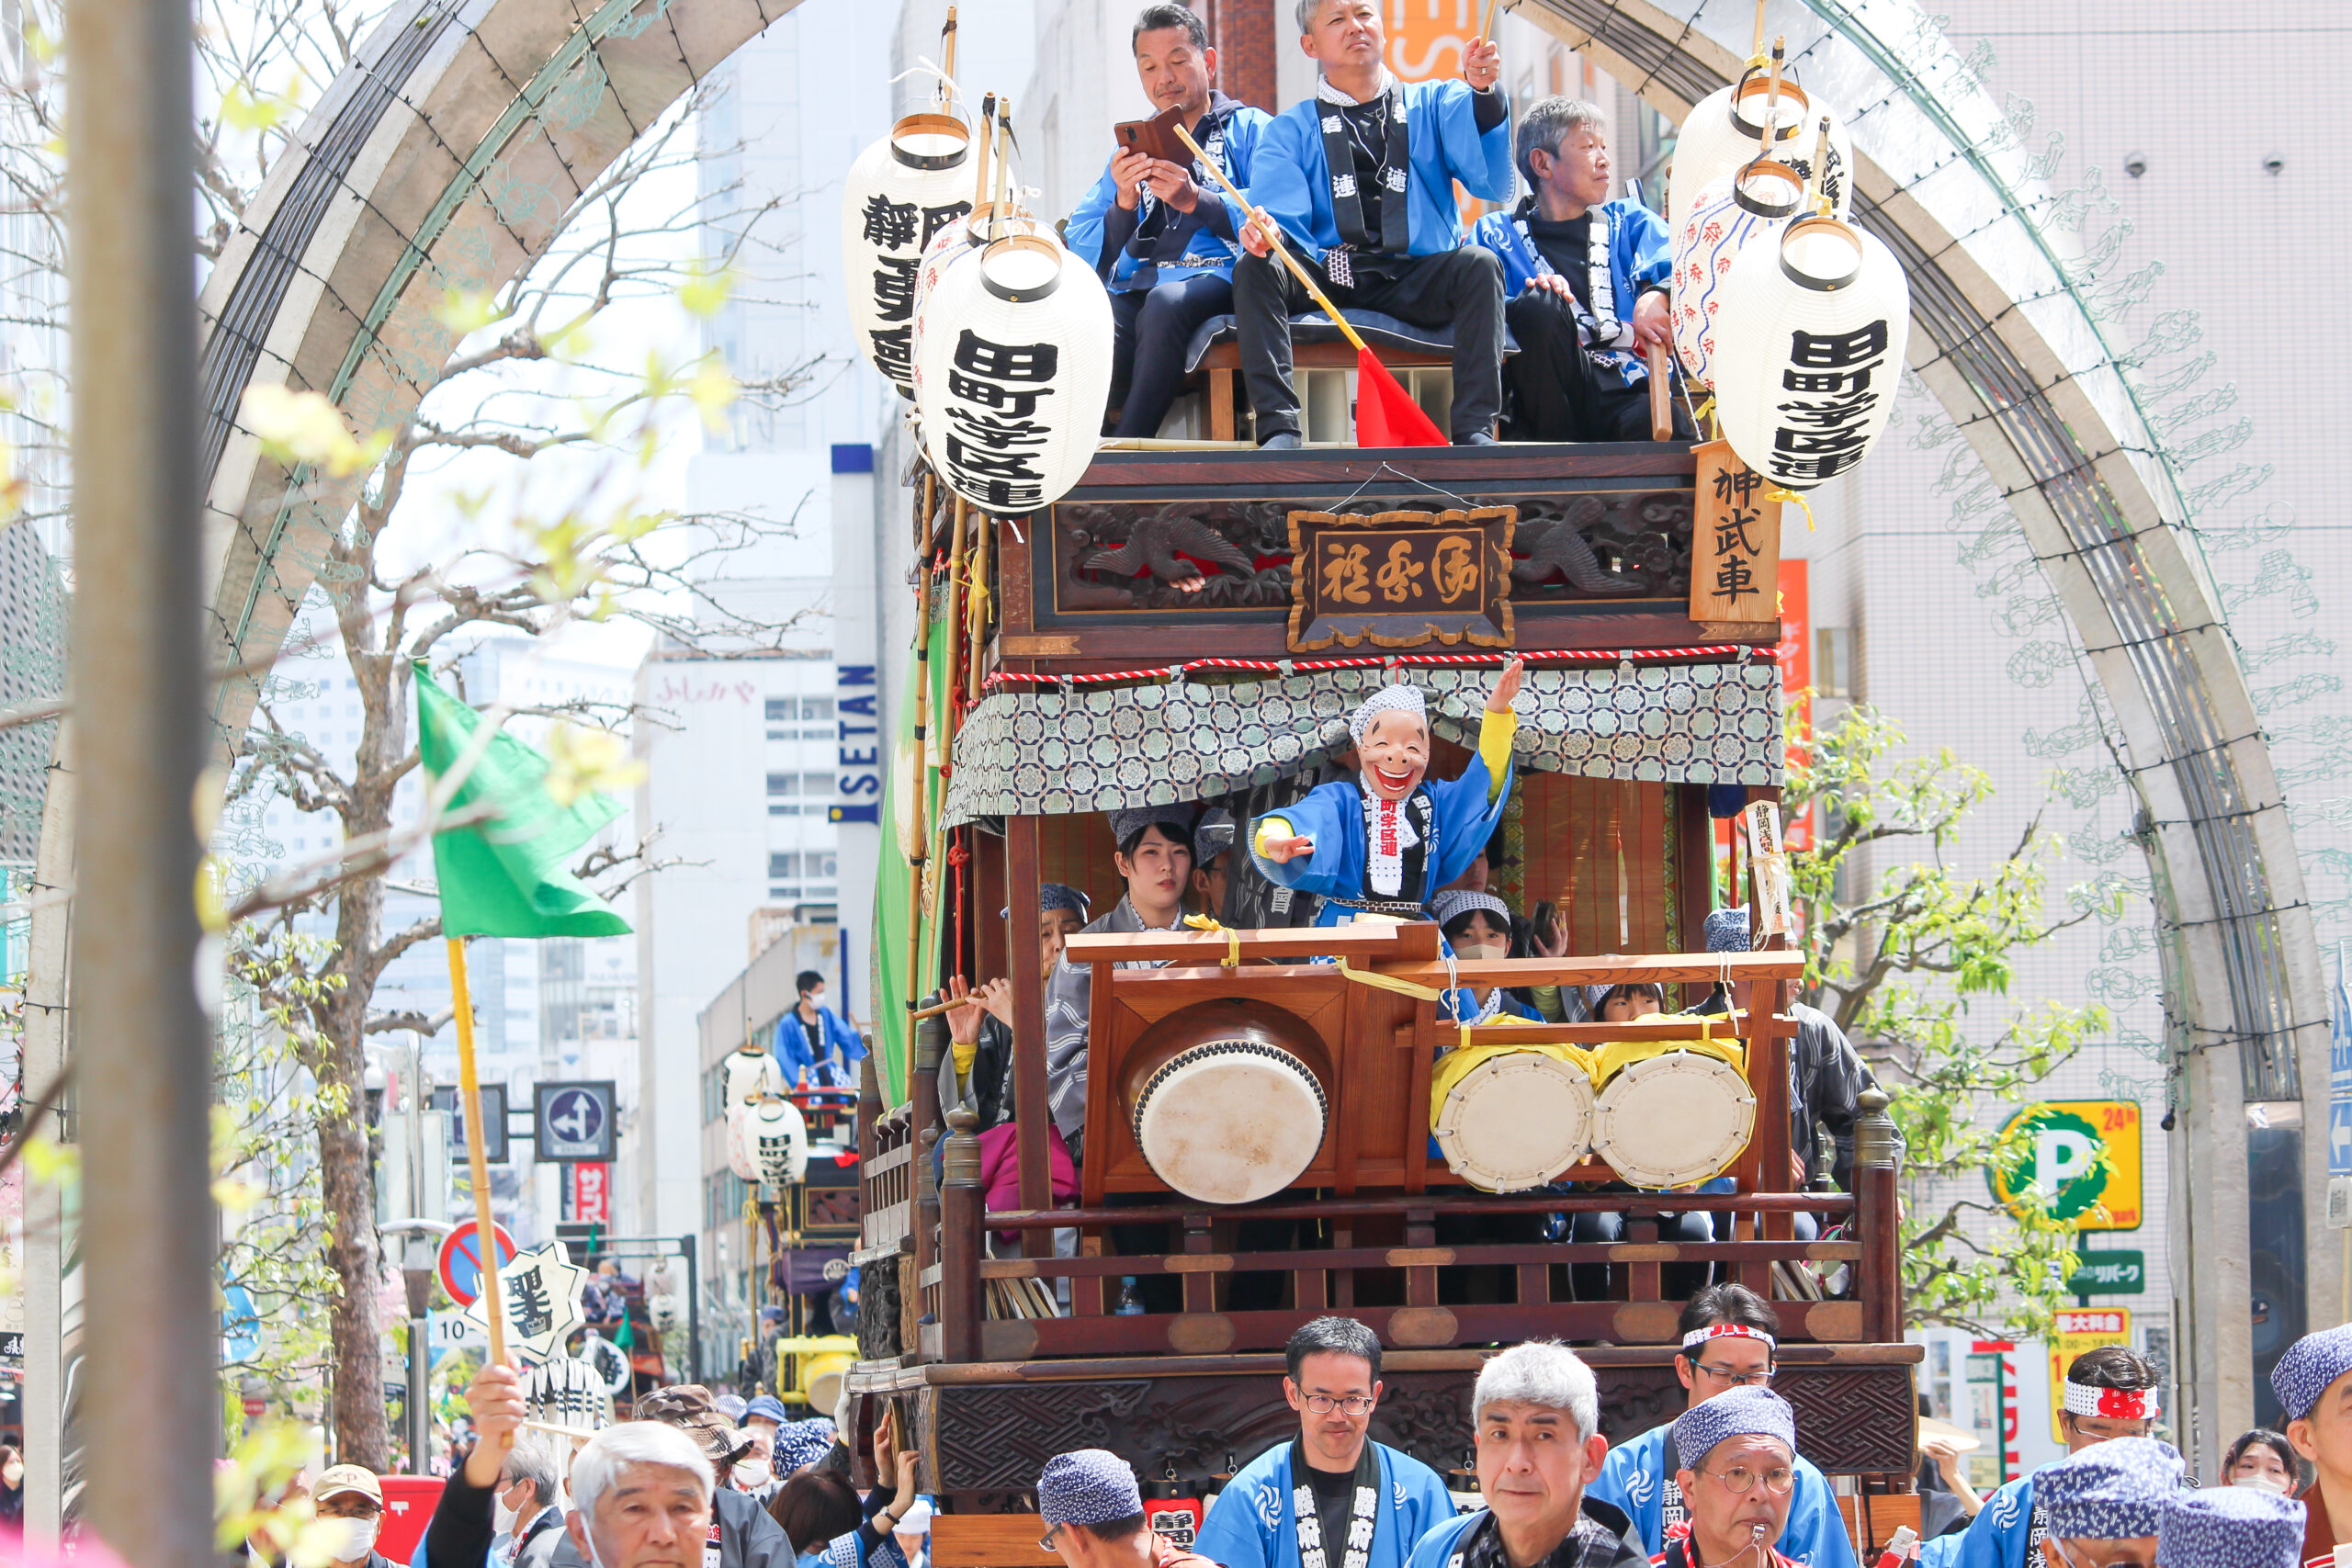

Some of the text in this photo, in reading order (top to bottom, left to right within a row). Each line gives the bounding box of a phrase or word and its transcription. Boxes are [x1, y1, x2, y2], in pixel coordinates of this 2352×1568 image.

[1712, 463, 1763, 606] 神武車
[829, 665, 879, 825] ISETAN
[2035, 1130, 2093, 1208] P
